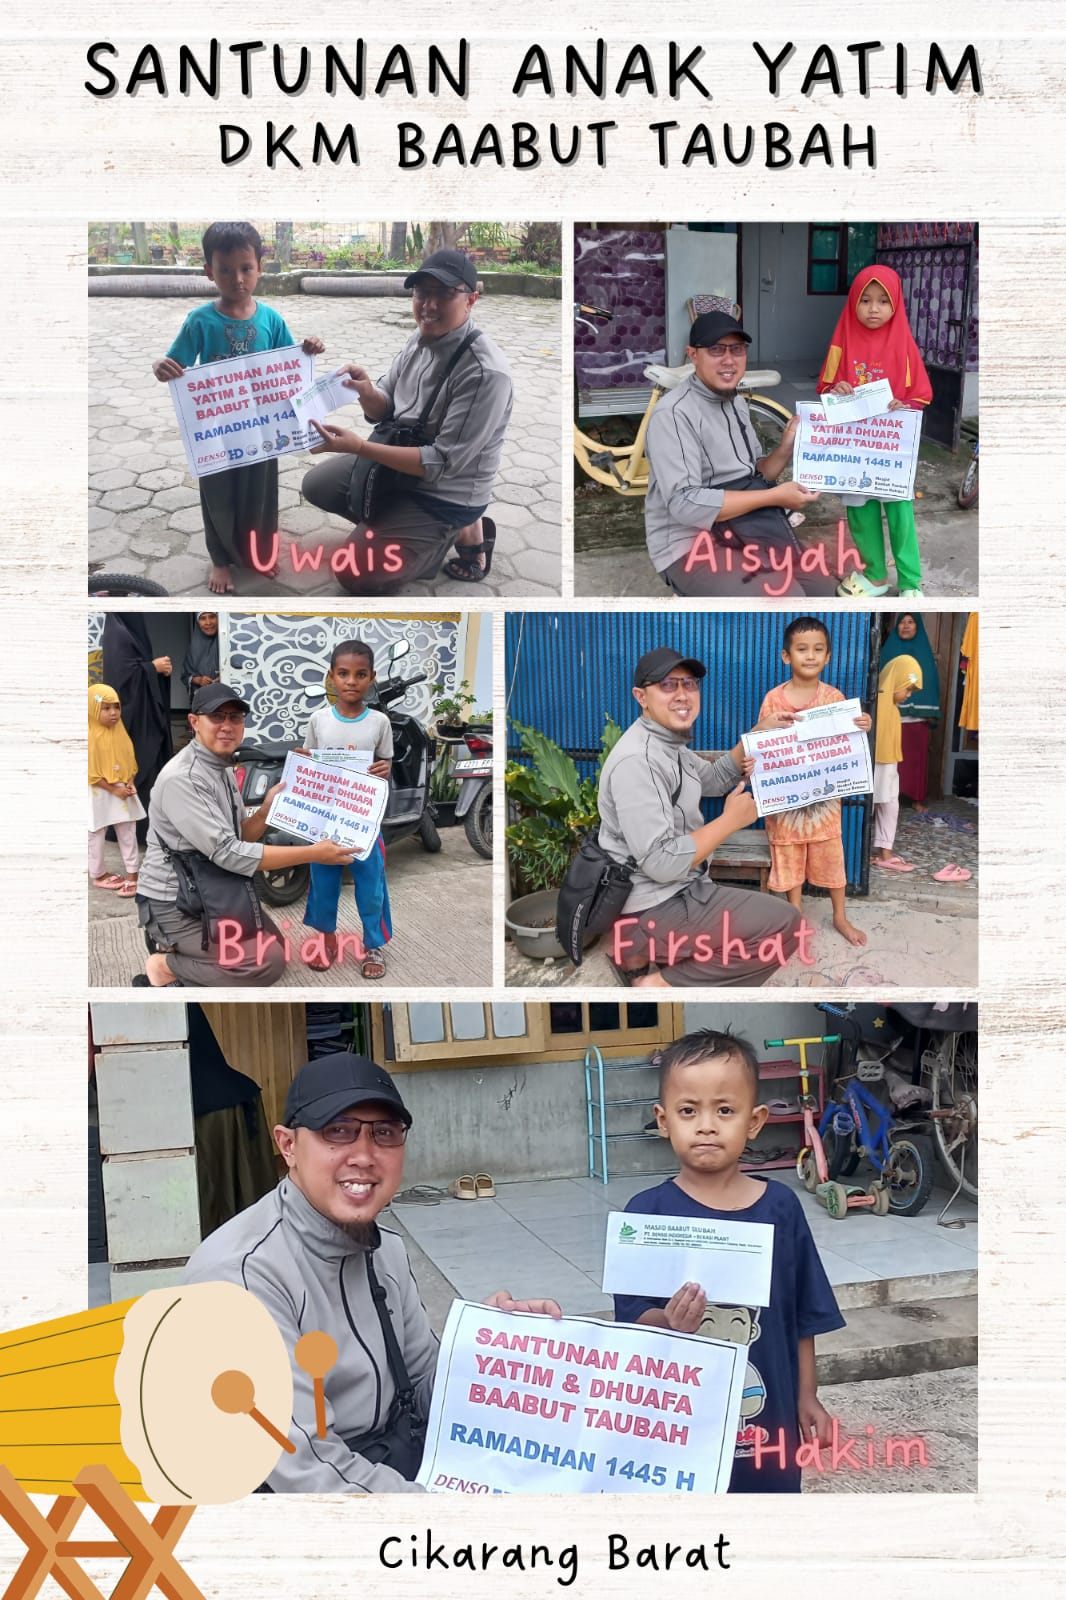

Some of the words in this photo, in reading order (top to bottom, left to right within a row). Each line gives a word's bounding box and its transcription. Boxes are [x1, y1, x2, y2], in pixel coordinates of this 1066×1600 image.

[187, 367, 262, 393] SANTUNAN
[266, 358, 301, 375] ANAK
[192, 386, 235, 406] YATIM
[239, 384, 248, 395] &
[251, 373, 303, 392] DHUAFA
[195, 400, 250, 420] BAABUT
[194, 414, 270, 442] RAMADHAN
[274, 409, 297, 423] 144
[812, 425, 844, 434] YATIM
[855, 428, 901, 440] DHUAFA
[871, 418, 904, 429] ANAK
[810, 435, 851, 447] BAABUT
[853, 439, 899, 452] TAUBAH
[197, 450, 227, 465] DENSO
[802, 451, 861, 465] RAMADHAN
[865, 457, 891, 468] 1445
[894, 461, 903, 469] H
[799, 473, 823, 481] DENSO
[757, 732, 799, 750] SANTU
[760, 746, 793, 760] YATIM
[797, 745, 804, 753] &
[807, 734, 850, 751] DHUAFA
[762, 756, 806, 771] BAABUT
[808, 745, 852, 761] TAUBAH
[296, 765, 350, 787] SANTUNAN
[351, 781, 377, 796] ANAK
[761, 769, 821, 788] RAMADHAN
[824, 762, 849, 774] 1445
[851, 760, 859, 768] H
[291, 785, 333, 804] BAABUT
[335, 798, 370, 817] TAUBAH
[295, 775, 325, 791] YATIM
[327, 786, 335, 794] &
[337, 787, 373, 807] DHUAFA
[762, 796, 785, 805] DENSO
[274, 812, 297, 825] DENSO
[283, 796, 337, 821] RAMADHAN
[339, 817, 360, 830] 1445
[361, 825, 369, 834] H
[475, 1327, 619, 1371] SANTUNAN
[625, 1354, 703, 1387] ANAK
[475, 1353, 554, 1388] YATIM
[561, 1374, 581, 1394] &
[589, 1379, 693, 1416] DHUAFA
[468, 1383, 576, 1423] BAABUT
[584, 1407, 689, 1446] TAUBAH
[450, 1422, 597, 1473] RAMADHAN
[605, 1459, 667, 1487] 1445
[676, 1470, 696, 1492] H
[434, 1474, 489, 1494] DENSO
